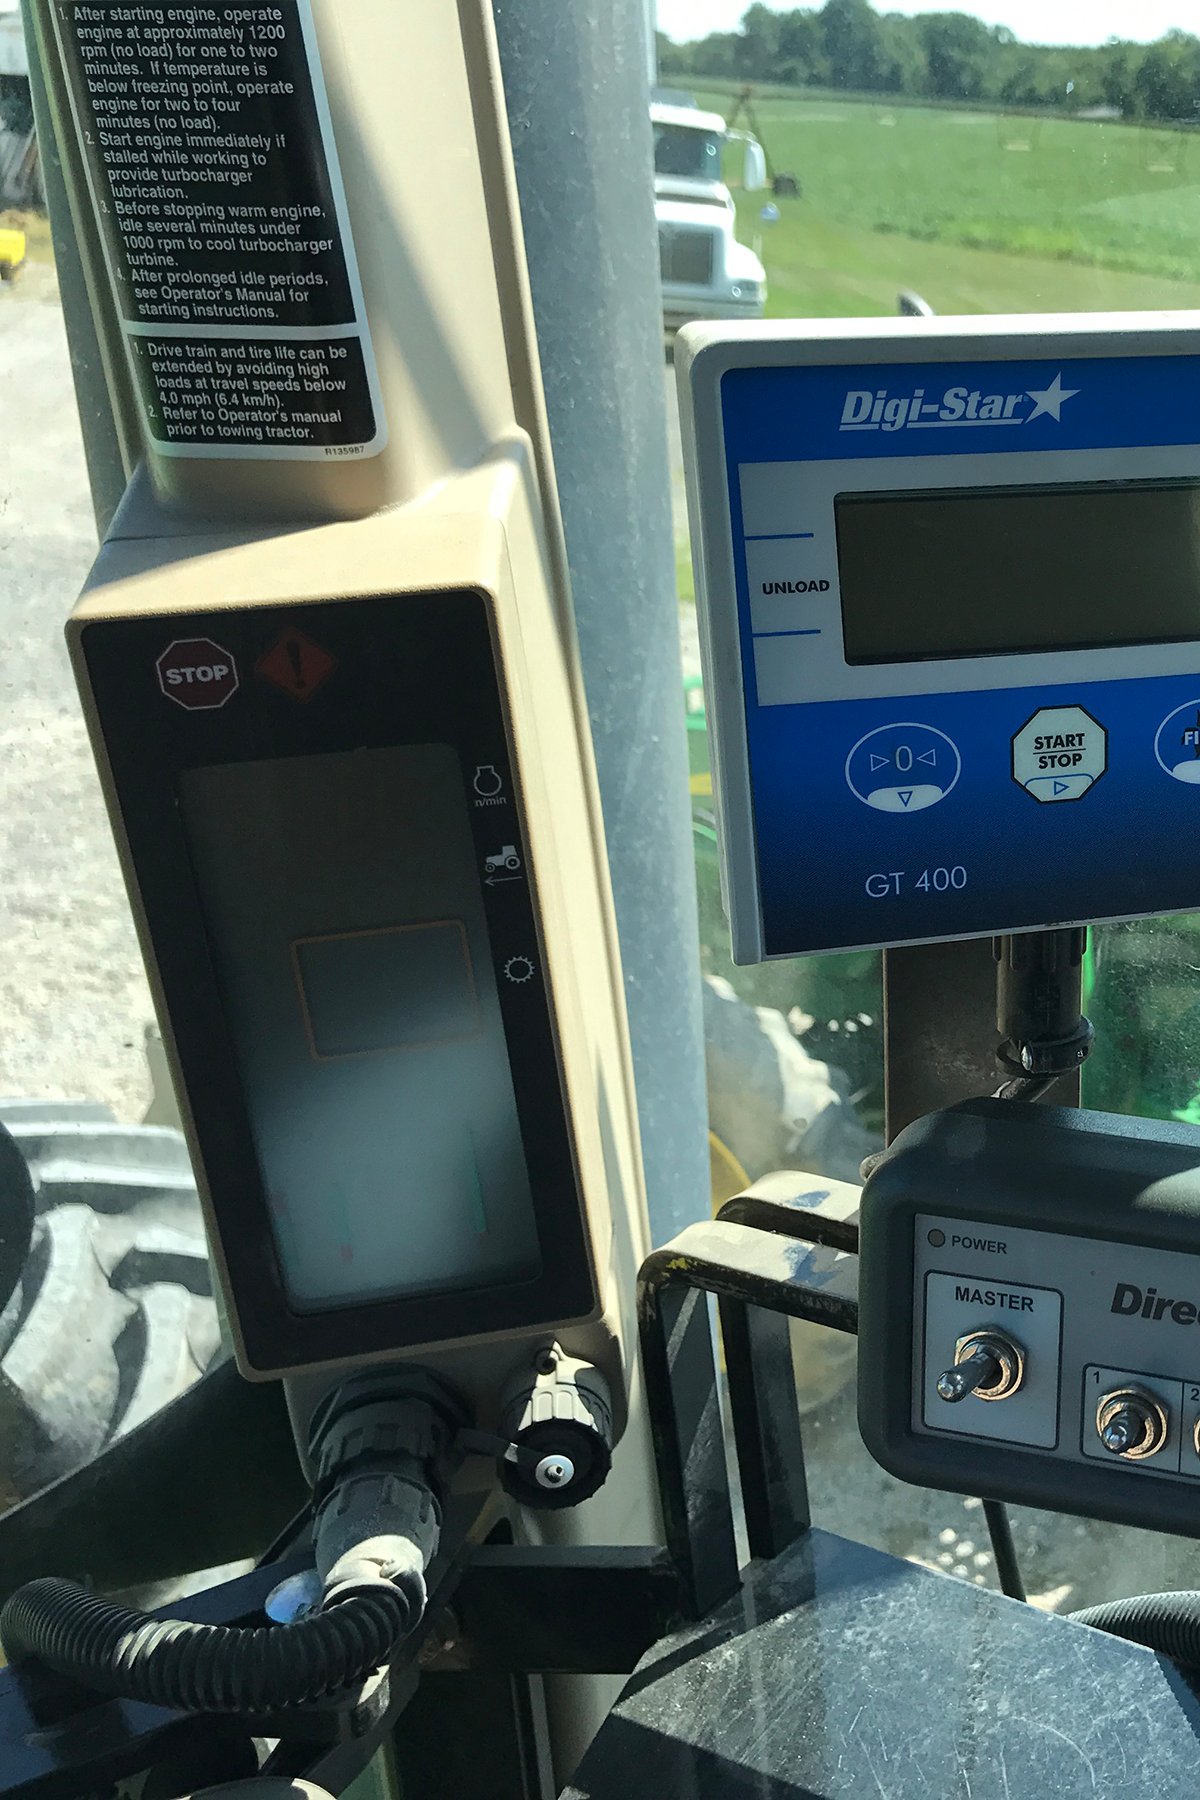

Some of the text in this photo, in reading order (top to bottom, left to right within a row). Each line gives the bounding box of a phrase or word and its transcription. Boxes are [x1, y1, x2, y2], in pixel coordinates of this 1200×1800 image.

[59, 7, 282, 24] 1. After starting engine, operate
[77, 25, 285, 42] engine at approximately 1200
[81, 44, 277, 60] rpm (no load) for one to two
[85, 61, 267, 79] minutes. If temperature is
[88, 80, 294, 97] below freezing point, operate
[93, 97, 240, 114] engine for two to four
[96, 115, 220, 132] minutes (no load).
[85, 132, 286, 151] 2. Start engine immediately if
[104, 151, 267, 169] stalled while working to
[108, 168, 253, 186] provide turbocharger
[111, 184, 188, 199] lubrication.
[101, 201, 325, 221] 3. Before stopping warm engine,
[119, 219, 300, 235] idle several minutes under
[124, 236, 333, 255] 1000 rpm to cool turbocharger
[126, 253, 178, 266] turbine.
[131, 269, 163, 282] After
[167, 270, 236, 286] prolonged
[240, 271, 265, 285] idle
[270, 272, 329, 287] periods,
[135, 286, 309, 304] see Operator's Manual for
[139, 303, 279, 319] starting instructions.
[134, 342, 347, 359] 1. Drive train and tire life can be
[152, 360, 329, 379] extended by avoiding high
[155, 375, 346, 393] loads at travel speeds below
[160, 391, 284, 408] 4.0 mph (6.4 km/h).
[149, 406, 342, 424] 2. Refer to Operator's manual
[839, 387, 1023, 431] Digi-Star
[167, 422, 314, 440] prior to towing tractor.
[324, 445, 364, 456] R135987
[762, 579, 830, 595] UNLOAD
[165, 664, 229, 685] STOP
[1033, 731, 1086, 751] START
[1038, 751, 1083, 770] STOP
[474, 795, 507, 807] n/min
[865, 866, 968, 898] GT 400
[951, 1235, 1008, 1254] POWER
[955, 1286, 1034, 1312] MASTER
[1093, 1371, 1100, 1384] 1
[1190, 1388, 1199, 1401] 2
